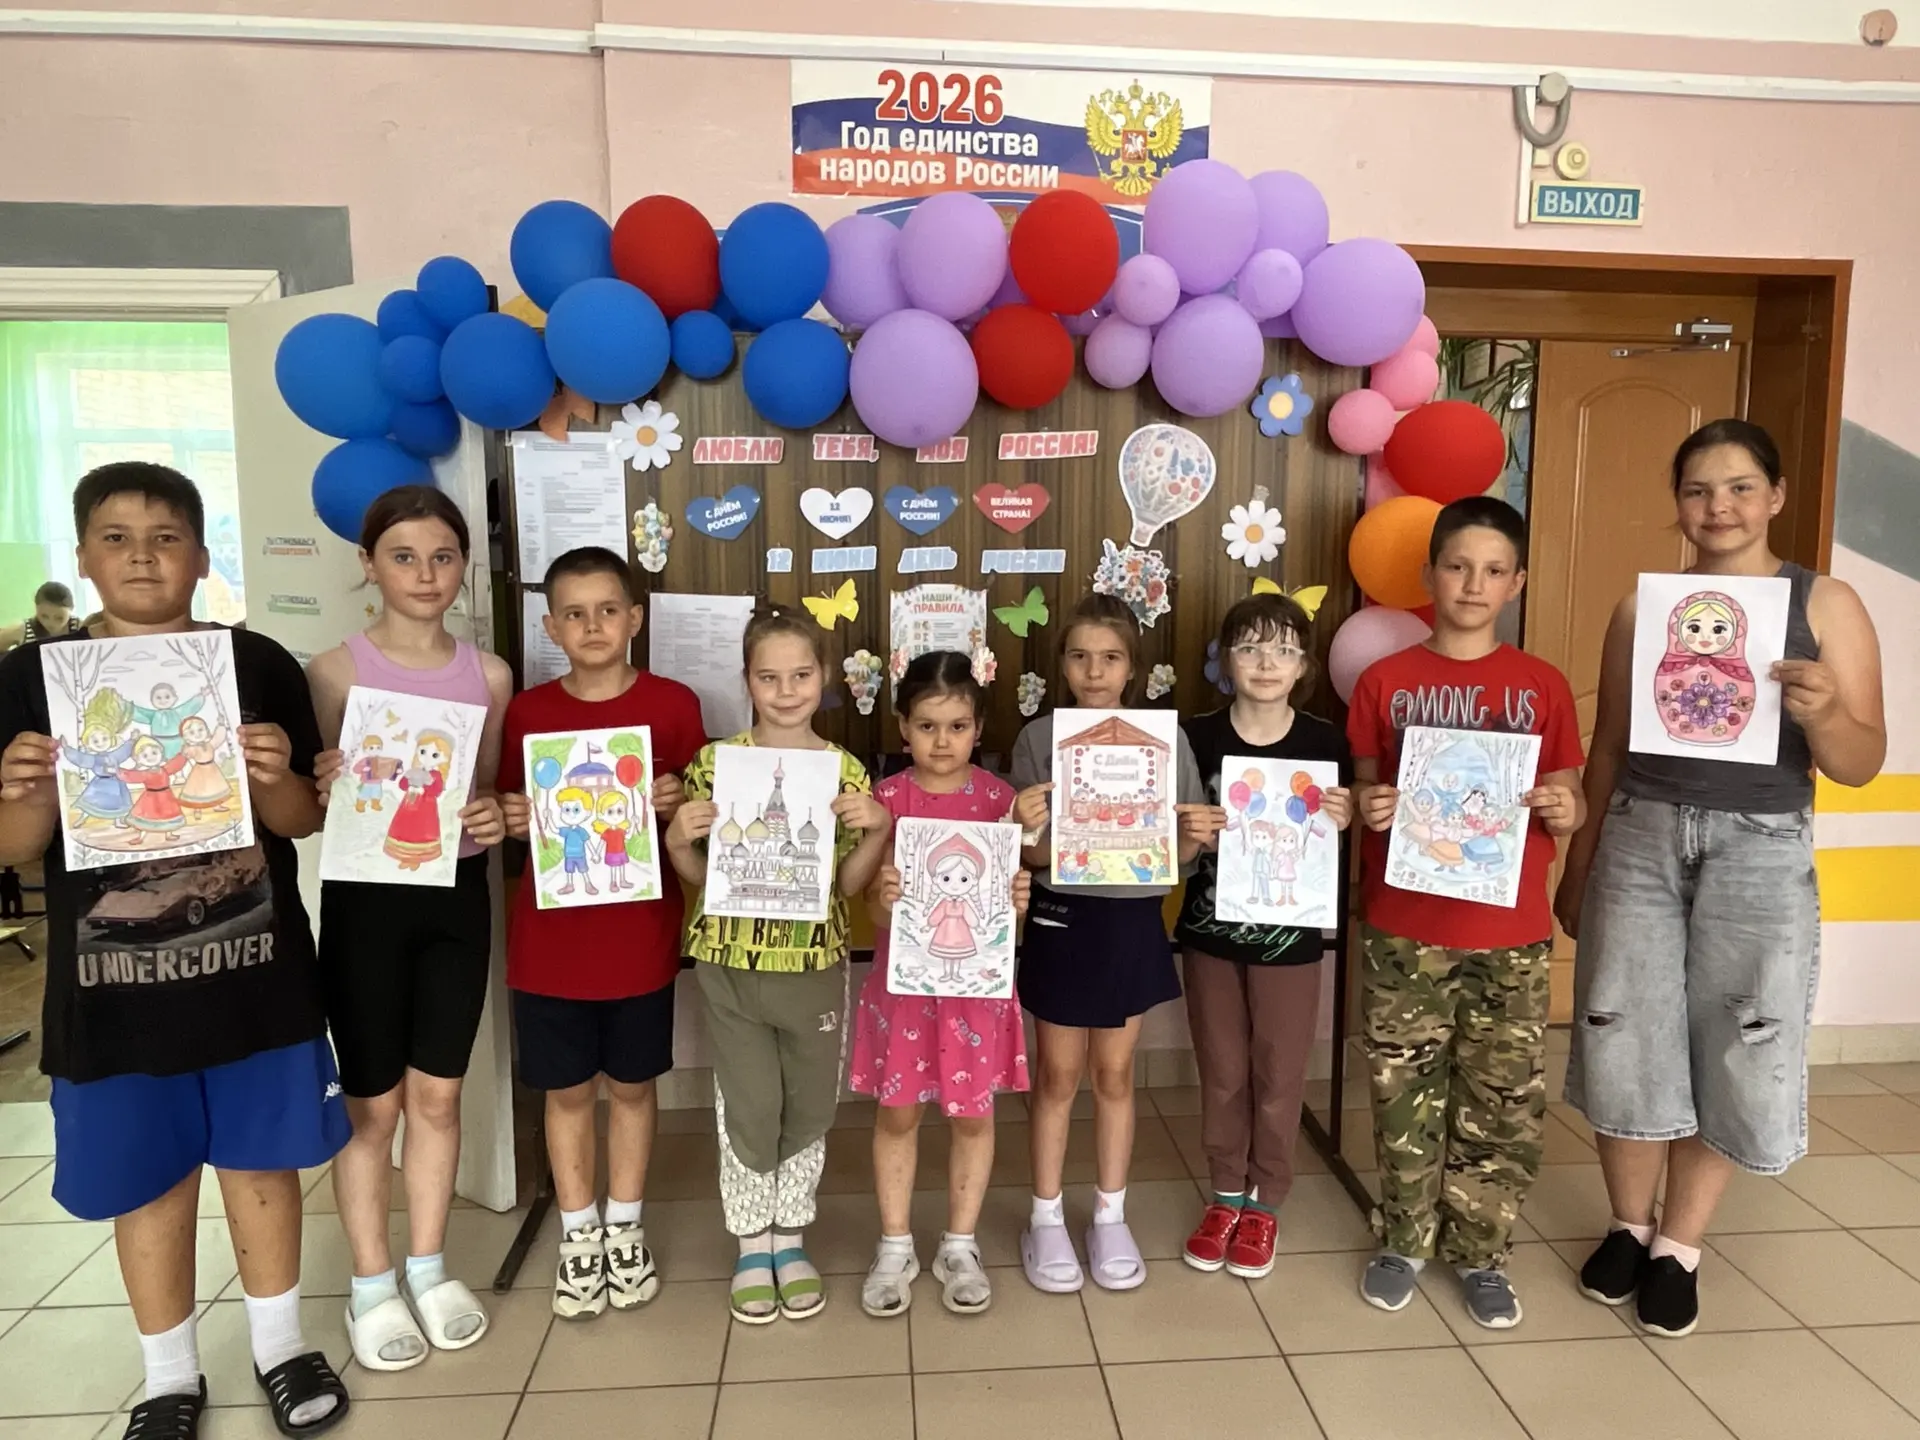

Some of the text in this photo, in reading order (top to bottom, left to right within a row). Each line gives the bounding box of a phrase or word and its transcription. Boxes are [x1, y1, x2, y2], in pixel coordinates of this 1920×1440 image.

[876, 69, 1004, 126] 2026
[840, 121, 1039, 157] Год единства
[820, 158, 1059, 188] народов России
[1543, 189, 1634, 219] ВЫХОД
[694, 438, 781, 462] ЛЮБЛЮ
[999, 432, 1097, 459] РОССИЯ!
[829, 502, 841, 512] 12
[902, 499, 910, 509] С
[990, 497, 1032, 506] ВЕЛИКАЯ
[705, 510, 713, 519] С
[899, 512, 940, 521] РОССИИ!
[992, 510, 1031, 519] СТРАНА!
[707, 512, 748, 532] РОССИИ!
[913, 603, 965, 614] ПРАВИЛА
[1505, 687, 1538, 730] US
[1093, 754, 1103, 765] С
[1092, 769, 1139, 782] России!
[78, 932, 275, 988] UNDERCOVER
